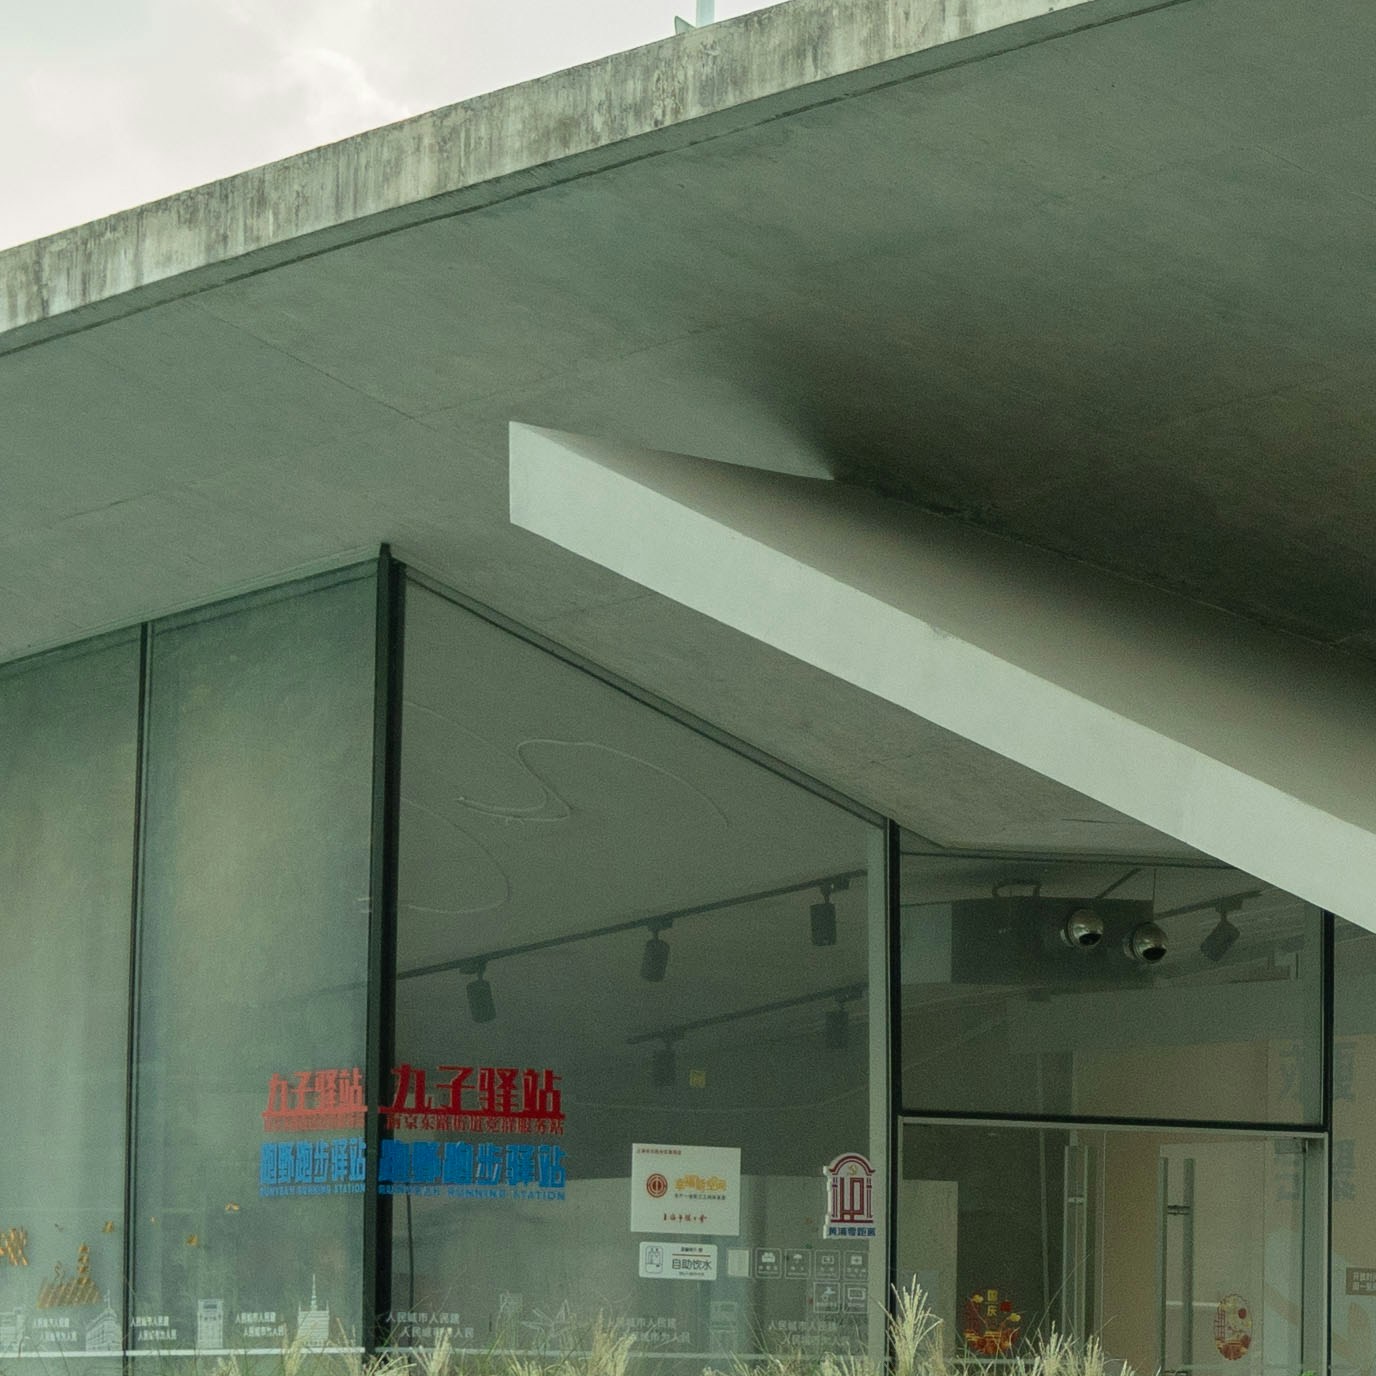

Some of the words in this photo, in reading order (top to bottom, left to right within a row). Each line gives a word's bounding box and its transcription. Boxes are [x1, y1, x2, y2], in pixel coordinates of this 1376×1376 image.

[263, 1067, 367, 1117] 九子驿站
[380, 1064, 565, 1119] 九子驿站
[379, 1139, 566, 1188] 跑野跑步驿站
[513, 1189, 565, 1201] STATION
[672, 1258, 713, 1271] 自助饮水
[401, 1326, 474, 1338] 人民城市人民
